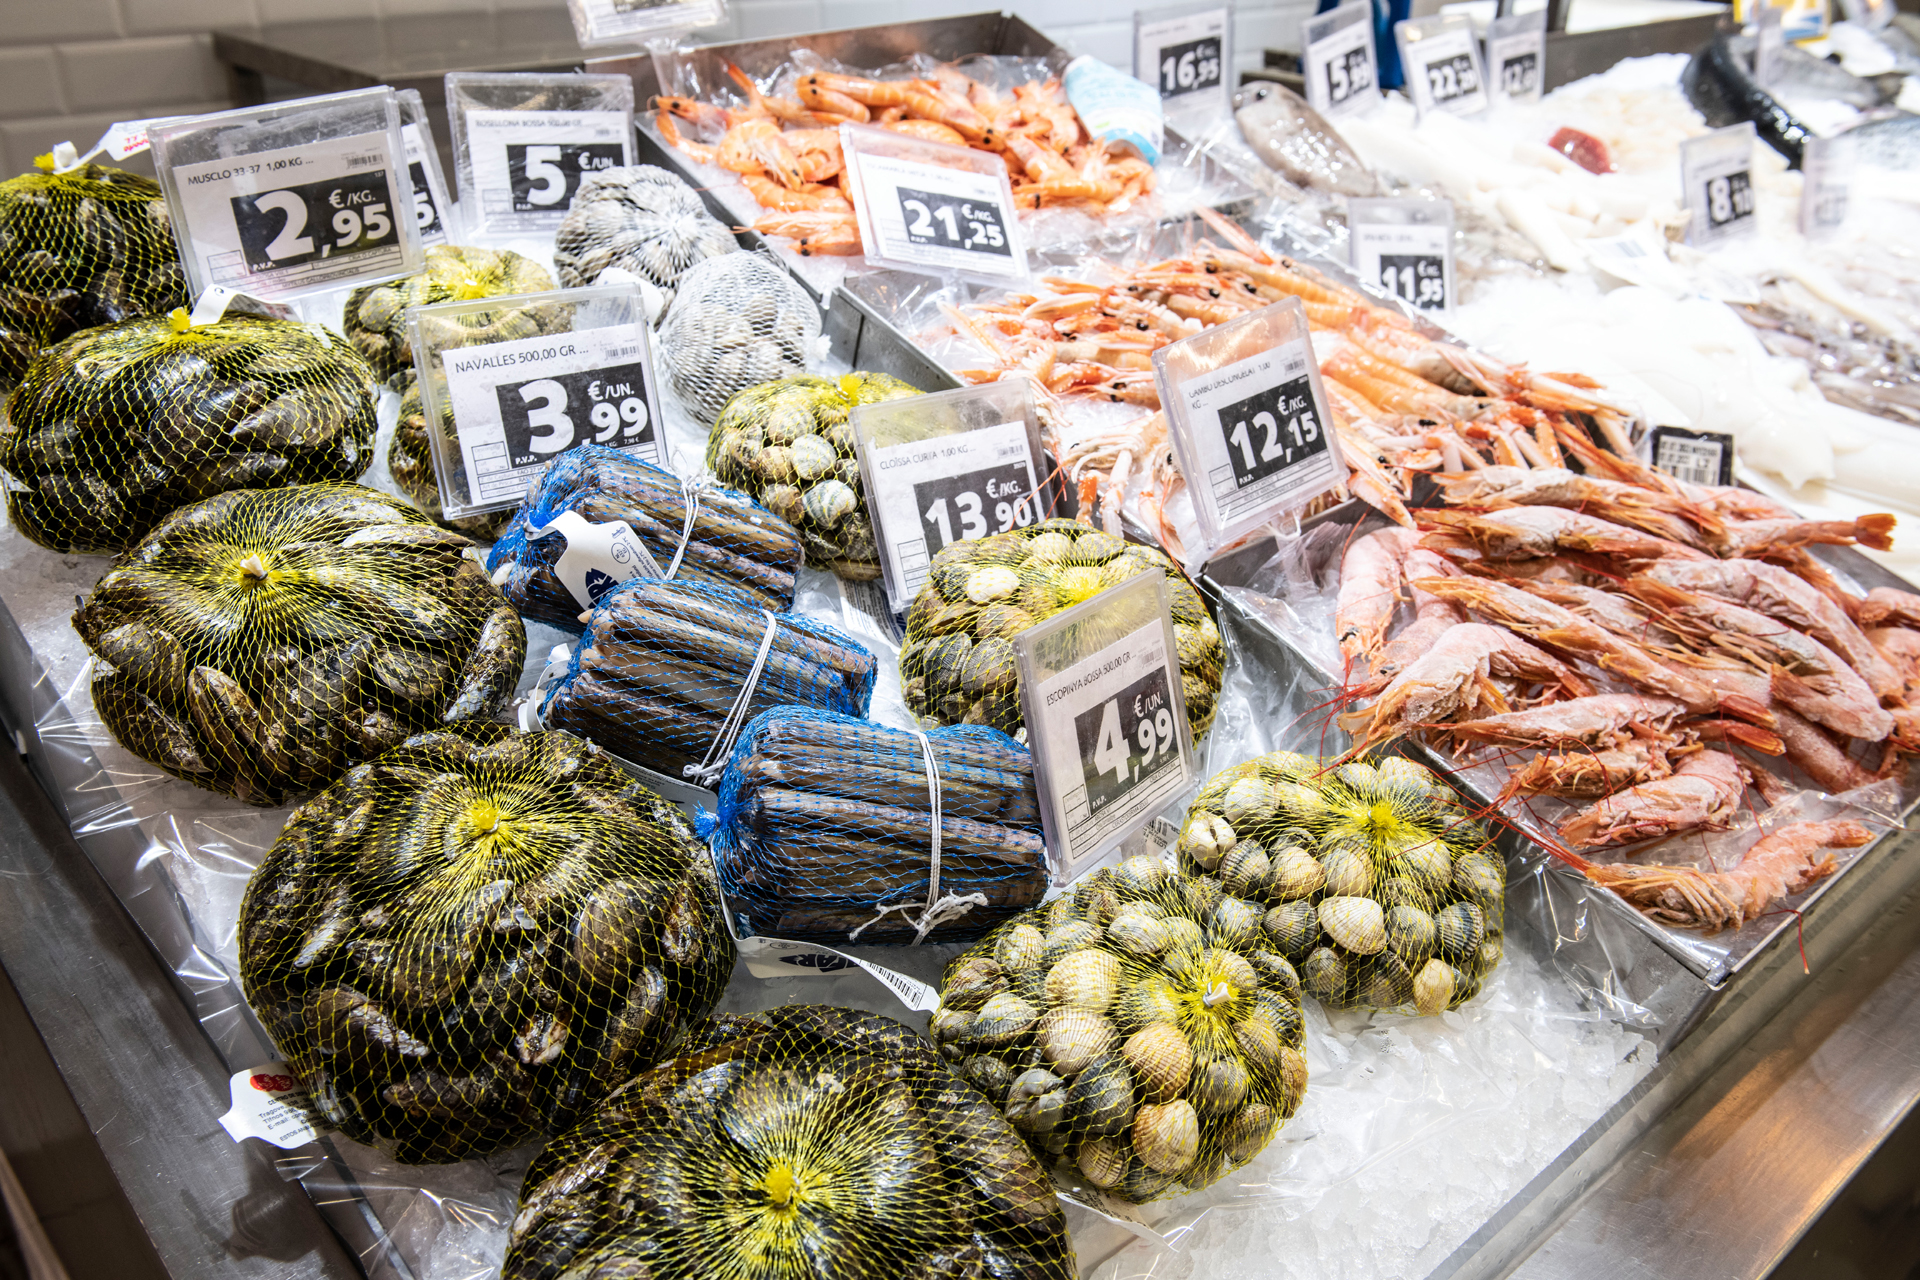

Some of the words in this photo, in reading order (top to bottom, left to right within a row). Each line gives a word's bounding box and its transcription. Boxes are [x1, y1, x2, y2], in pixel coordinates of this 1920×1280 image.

[1161, 51, 1219, 91] 16,95
[187, 169, 232, 186] MUSCLO
[233, 164, 261, 177] 33-37
[266, 159, 287, 173] 1,00
[288, 156, 303, 169] KG
[902, 199, 1005, 250] 21,25
[253, 261, 276, 271] P.V.P.
[1381, 265, 1444, 307] 11,95
[455, 354, 516, 374] NAVALLES
[518, 347, 557, 366] 500,00
[559, 344, 577, 356] GR
[515, 454, 537, 465] P.V.P.
[880, 455, 912, 471] CLOÏSSA
[941, 447, 956, 459] 1,00
[957, 444, 969, 454] KG
[1229, 410, 1319, 471] 12,15
[924, 490, 1033, 549] 13,90
[1046, 678, 1084, 707] ESCOPINYA
[1083, 667, 1103, 687] BOSSA
[1103, 657, 1123, 678] 500,00
[1093, 697, 1174, 784] 4,99
